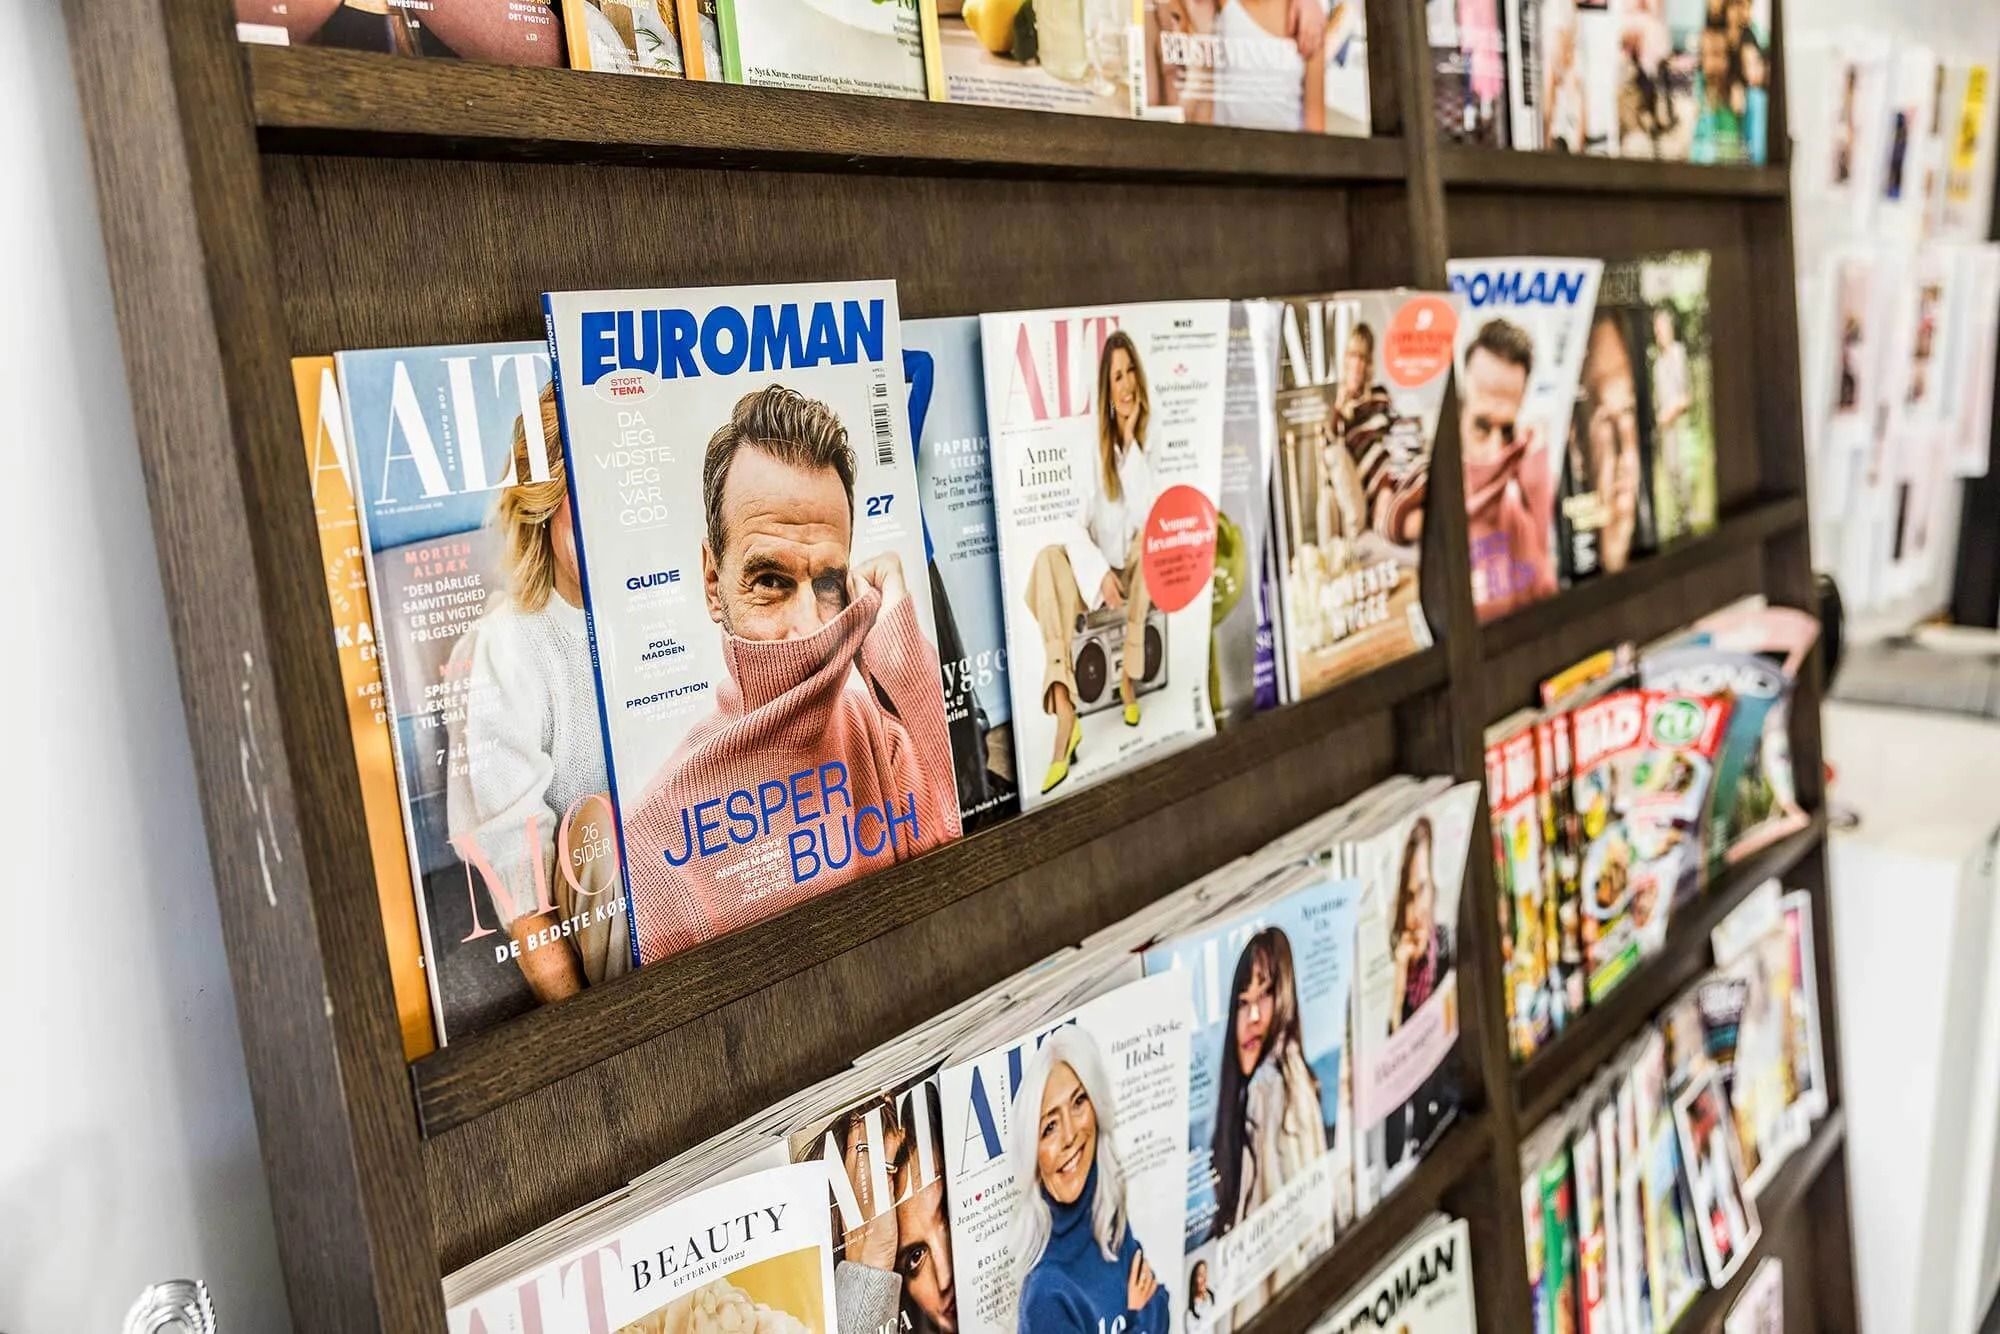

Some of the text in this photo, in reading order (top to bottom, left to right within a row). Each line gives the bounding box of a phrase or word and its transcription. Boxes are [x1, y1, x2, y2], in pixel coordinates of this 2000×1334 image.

[508, 13, 550, 24] DET VIGTIGT
[509, 3, 536, 13] DERFOR
[544, 314, 558, 359] EUROMAN
[581, 299, 885, 386] EUROMAN
[1001, 315, 1120, 425] ALT
[610, 376, 643, 387] STORT
[610, 386, 645, 396] TEMA
[374, 353, 559, 505] ALT
[617, 410, 646, 428] DA
[612, 429, 656, 448] JEG
[934, 437, 989, 457] PAPRIK
[594, 446, 676, 470] VIDSTE,
[950, 455, 985, 469] STEEN
[1024, 446, 1067, 465] Anne
[618, 467, 661, 488] JEG
[1020, 464, 1072, 487] Linnet
[620, 487, 663, 506] VAR
[950, 488, 965, 498] film
[620, 505, 668, 526] GOD
[866, 494, 895, 518] 27
[404, 543, 472, 565] MORTEN
[949, 546, 999, 562] STORE TENDEN
[414, 560, 469, 579] ALBÆK
[626, 569, 681, 591] GUIDE
[435, 574, 481, 593] DÅRLIGE
[402, 589, 486, 615] SAMVITTIGHED
[411, 604, 484, 628] ER EN VIGTIG
[641, 645, 686, 663] MADSEN
[648, 638, 677, 651] POUL
[942, 647, 1007, 698] ygge
[424, 681, 461, 698] SPIS &
[626, 681, 710, 710] PROSTITUTION
[417, 695, 458, 715] LÆKRE
[421, 706, 467, 729] TIL SMÅ
[436, 748, 447, 766] 7
[663, 760, 851, 867] JESPER
[581, 822, 599, 844] 26
[788, 791, 920, 885] BUCH
[573, 838, 612, 867] SIDER
[446, 794, 621, 943] MO
[495, 896, 628, 964] DE BEDSTE KØB
[1126, 1040, 1166, 1071] Holst
[963, 1176, 1015, 1208] VI DENIM
[630, 1202, 788, 1293] BEAUTY
[978, 1245, 1009, 1269] BOLIG
